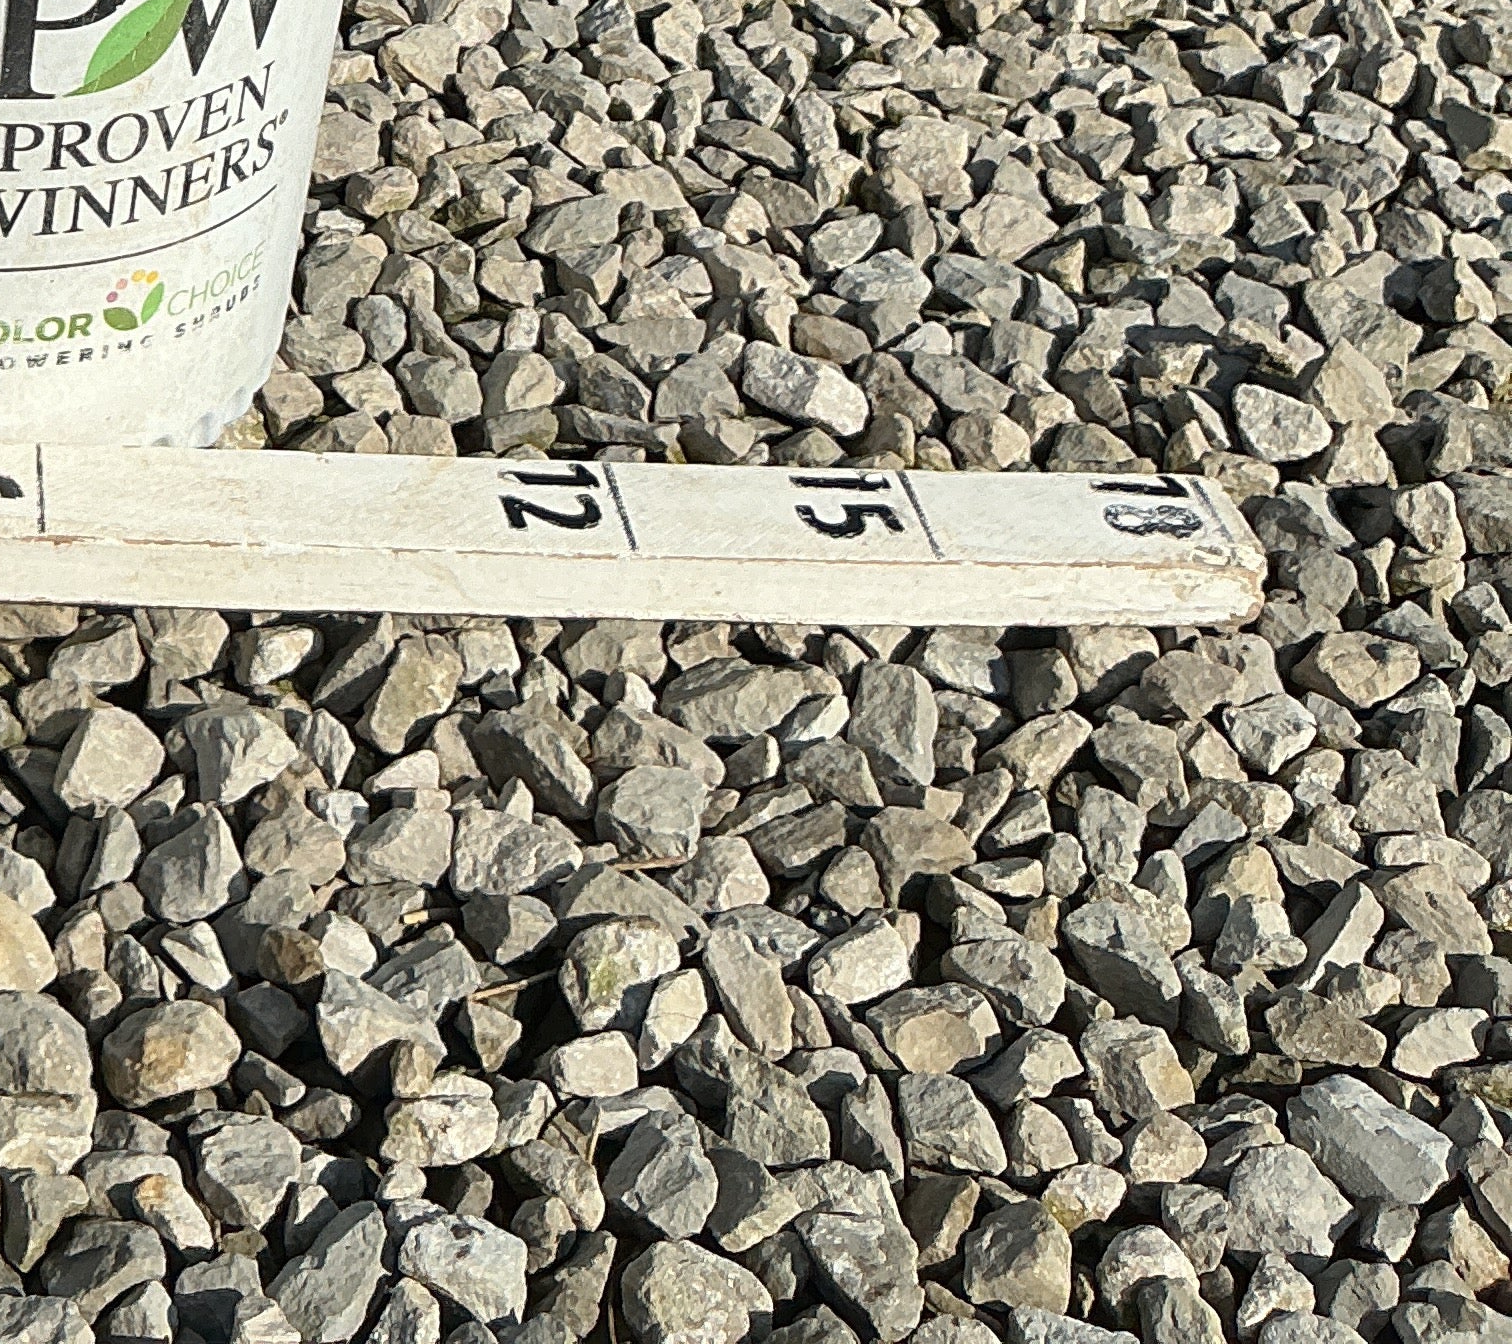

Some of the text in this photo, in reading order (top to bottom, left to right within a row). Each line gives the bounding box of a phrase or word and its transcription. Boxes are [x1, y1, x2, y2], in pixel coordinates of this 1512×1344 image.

[167, 239, 266, 317] CHOICE
[498, 462, 602, 531] 12
[788, 471, 905, 538] 15
[1089, 475, 1203, 539] 18
